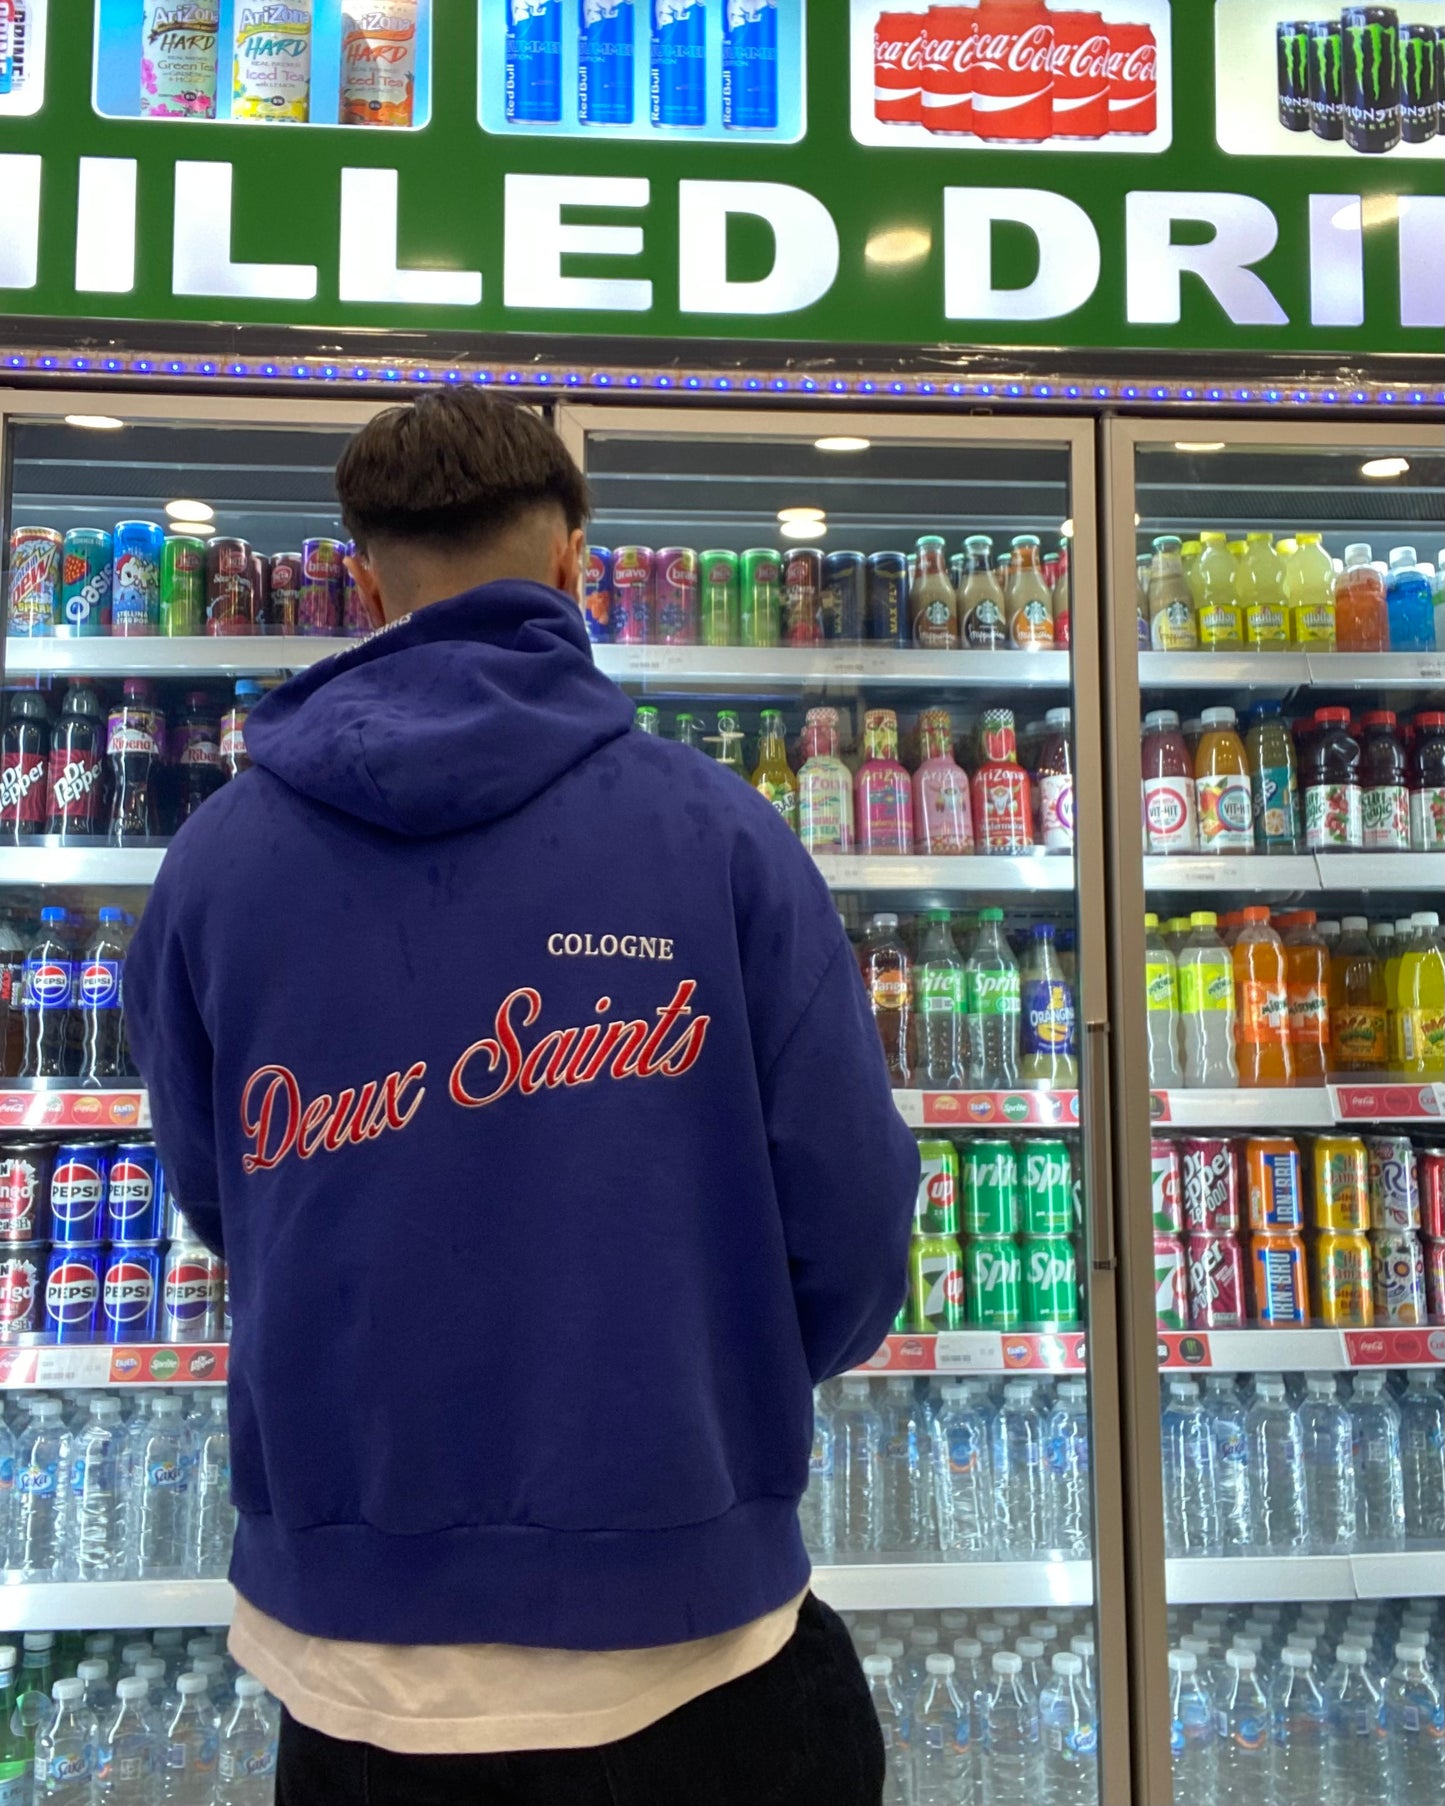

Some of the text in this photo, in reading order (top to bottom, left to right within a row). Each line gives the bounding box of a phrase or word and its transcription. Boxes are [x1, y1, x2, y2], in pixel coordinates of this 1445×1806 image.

[160, 33, 215, 53] HARD
[245, 37, 307, 60] HARD
[158, 60, 197, 70] Green
[347, 44, 407, 65] HARD
[246, 67, 304, 81] Iced Tea
[506, 64, 515, 116] Red Bull
[578, 66, 588, 119] Red Bull
[650, 69, 660, 121] Red Bull
[722, 71, 732, 123] Red Bull
[0, 153, 839, 315] ILLED
[615, 569, 647, 580] bravo
[113, 739, 152, 752] Ribena
[2, 762, 22, 791] Dr
[54, 759, 102, 809] Pepper
[63, 760, 85, 786] Dr
[548, 933, 674, 960] COLOGNE
[974, 970, 1020, 997] Sprit
[241, 979, 710, 1174] Deux Saints
[1003, 1103, 1028, 1113] Sprite
[52, 1185, 98, 1198] PEPSI
[109, 1185, 149, 1198] PEPSI
[48, 1286, 97, 1299] PEPSI
[105, 1286, 150, 1299] PEPSI
[166, 1285, 213, 1299] PEPSI
[922, 1257, 950, 1316] 7
[151, 1358, 178, 1370] Sprite
